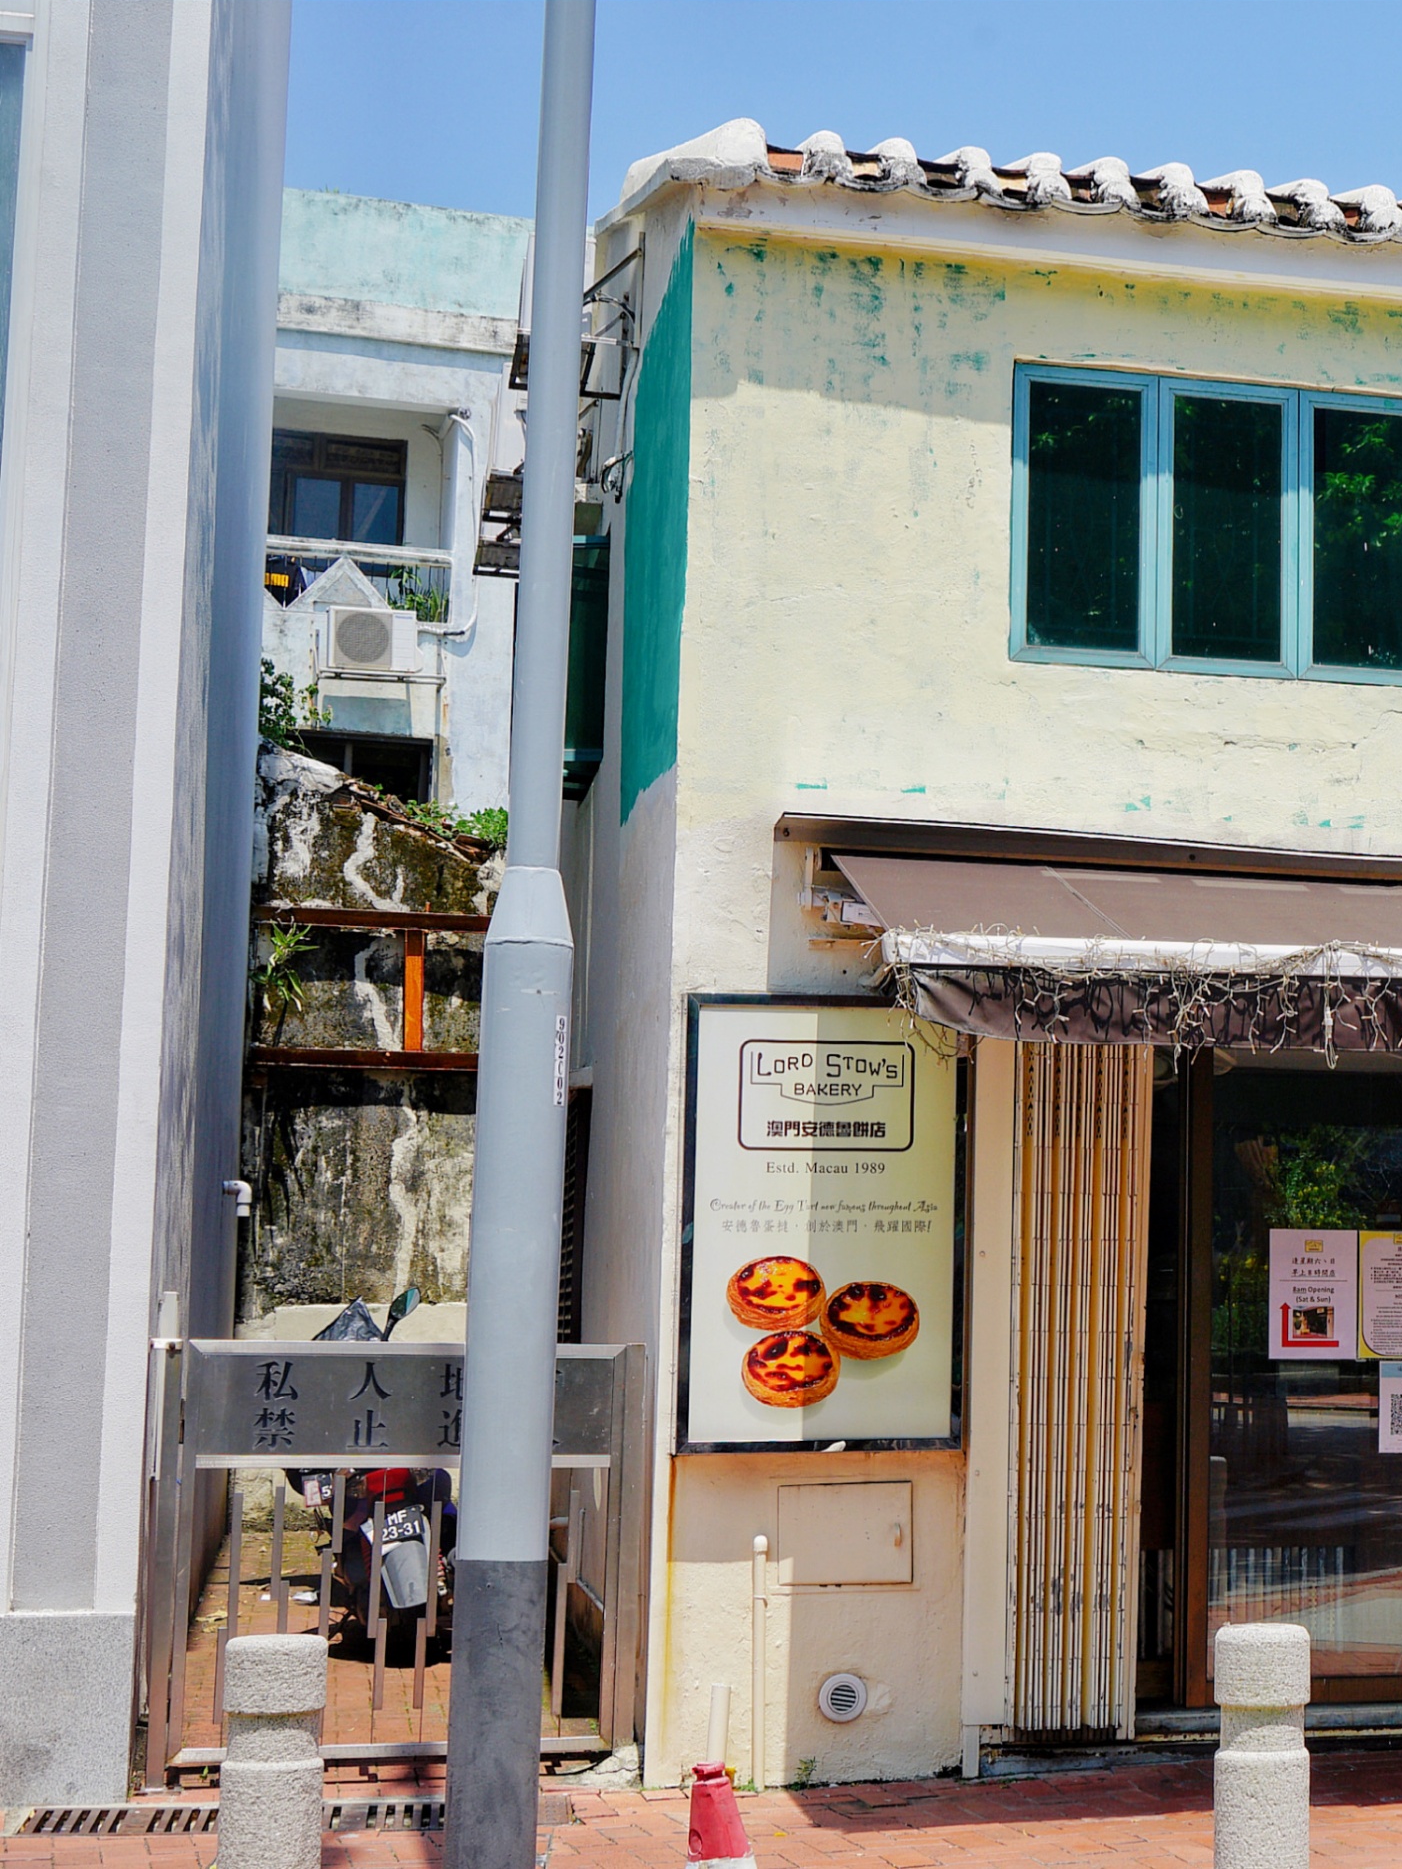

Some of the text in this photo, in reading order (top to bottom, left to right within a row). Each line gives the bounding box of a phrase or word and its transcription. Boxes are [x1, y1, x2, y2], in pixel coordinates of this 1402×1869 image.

[757, 1051, 898, 1079] LORD STOW'S
[794, 1083, 862, 1096] BAKERY
[766, 1120, 887, 1138] 澳門安德魯餅店
[766, 1161, 885, 1174] Estd. Macau 1989
[710, 1198, 746, 1212] Creator
[758, 1199, 771, 1211] the
[774, 1199, 794, 1215] Egg
[797, 1199, 819, 1212] Tart
[835, 1200, 866, 1214] famous
[868, 1199, 911, 1214] throughout
[913, 1200, 938, 1213] Asia
[1308, 1286, 1334, 1294] Opening
[388, 1510, 407, 1525] MF
[381, 1520, 420, 1542] 23-31
